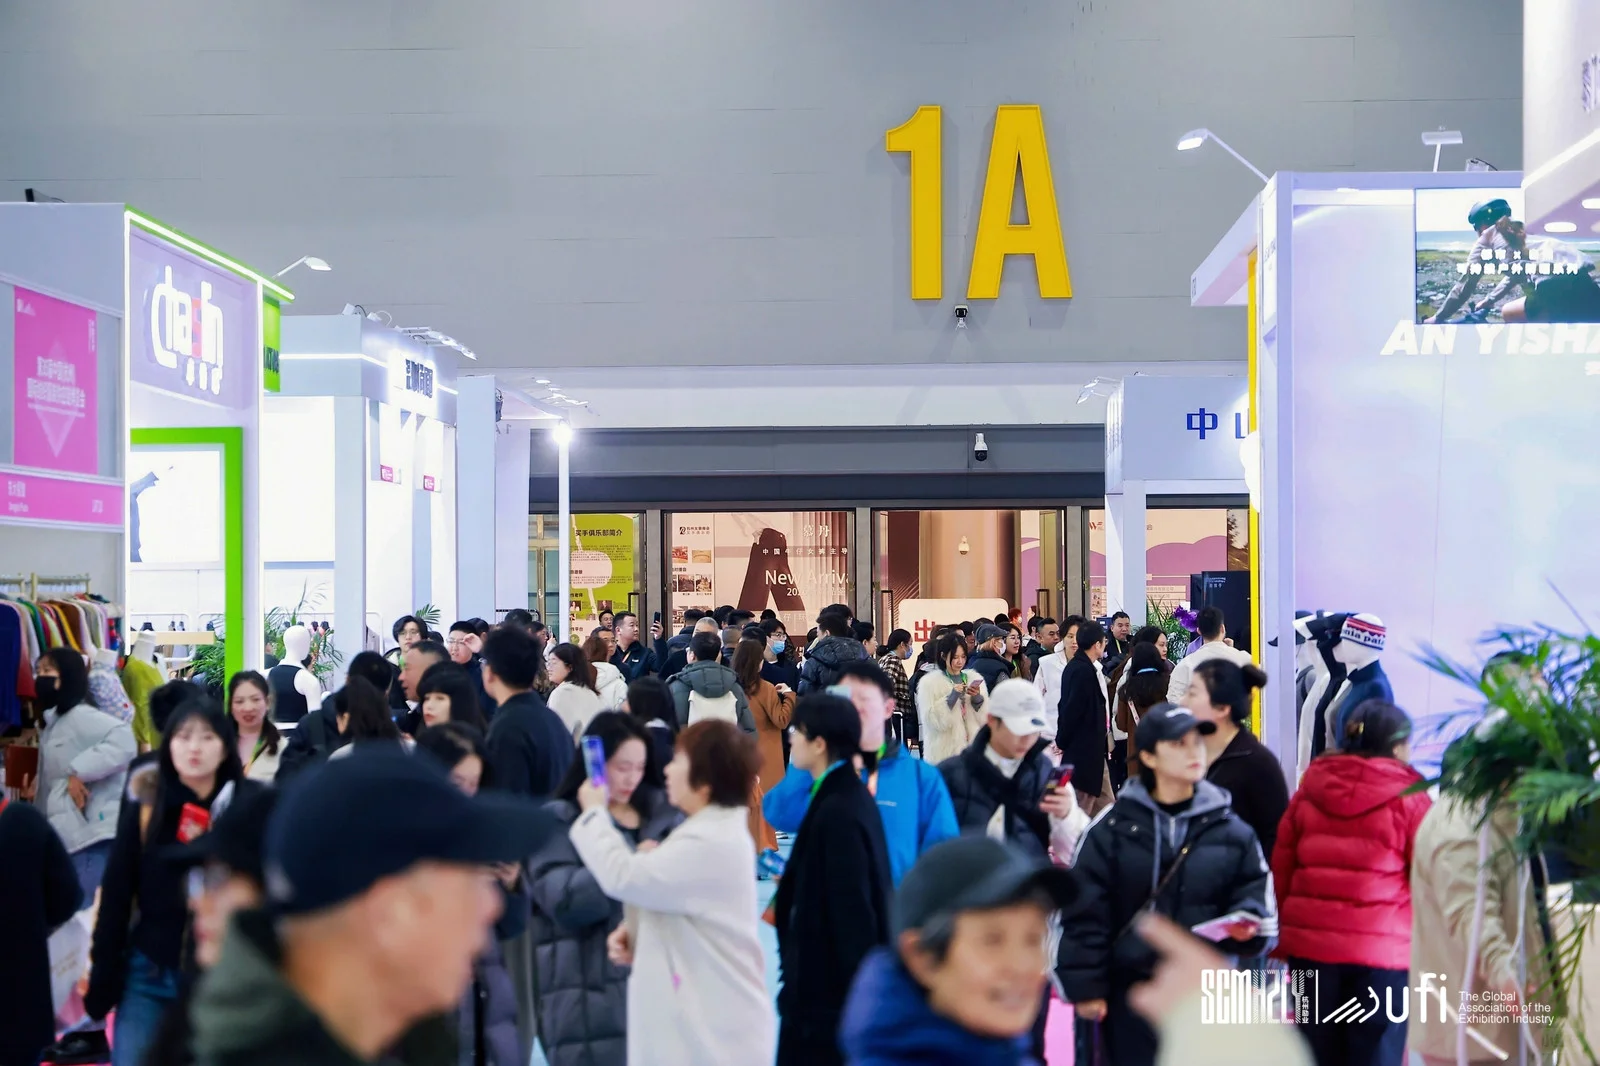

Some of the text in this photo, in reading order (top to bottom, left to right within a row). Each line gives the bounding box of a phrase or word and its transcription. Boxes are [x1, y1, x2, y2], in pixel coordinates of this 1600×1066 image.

[885, 104, 1073, 300] 1A
[1381, 320, 1457, 355] AN
[765, 569, 801, 585] New
